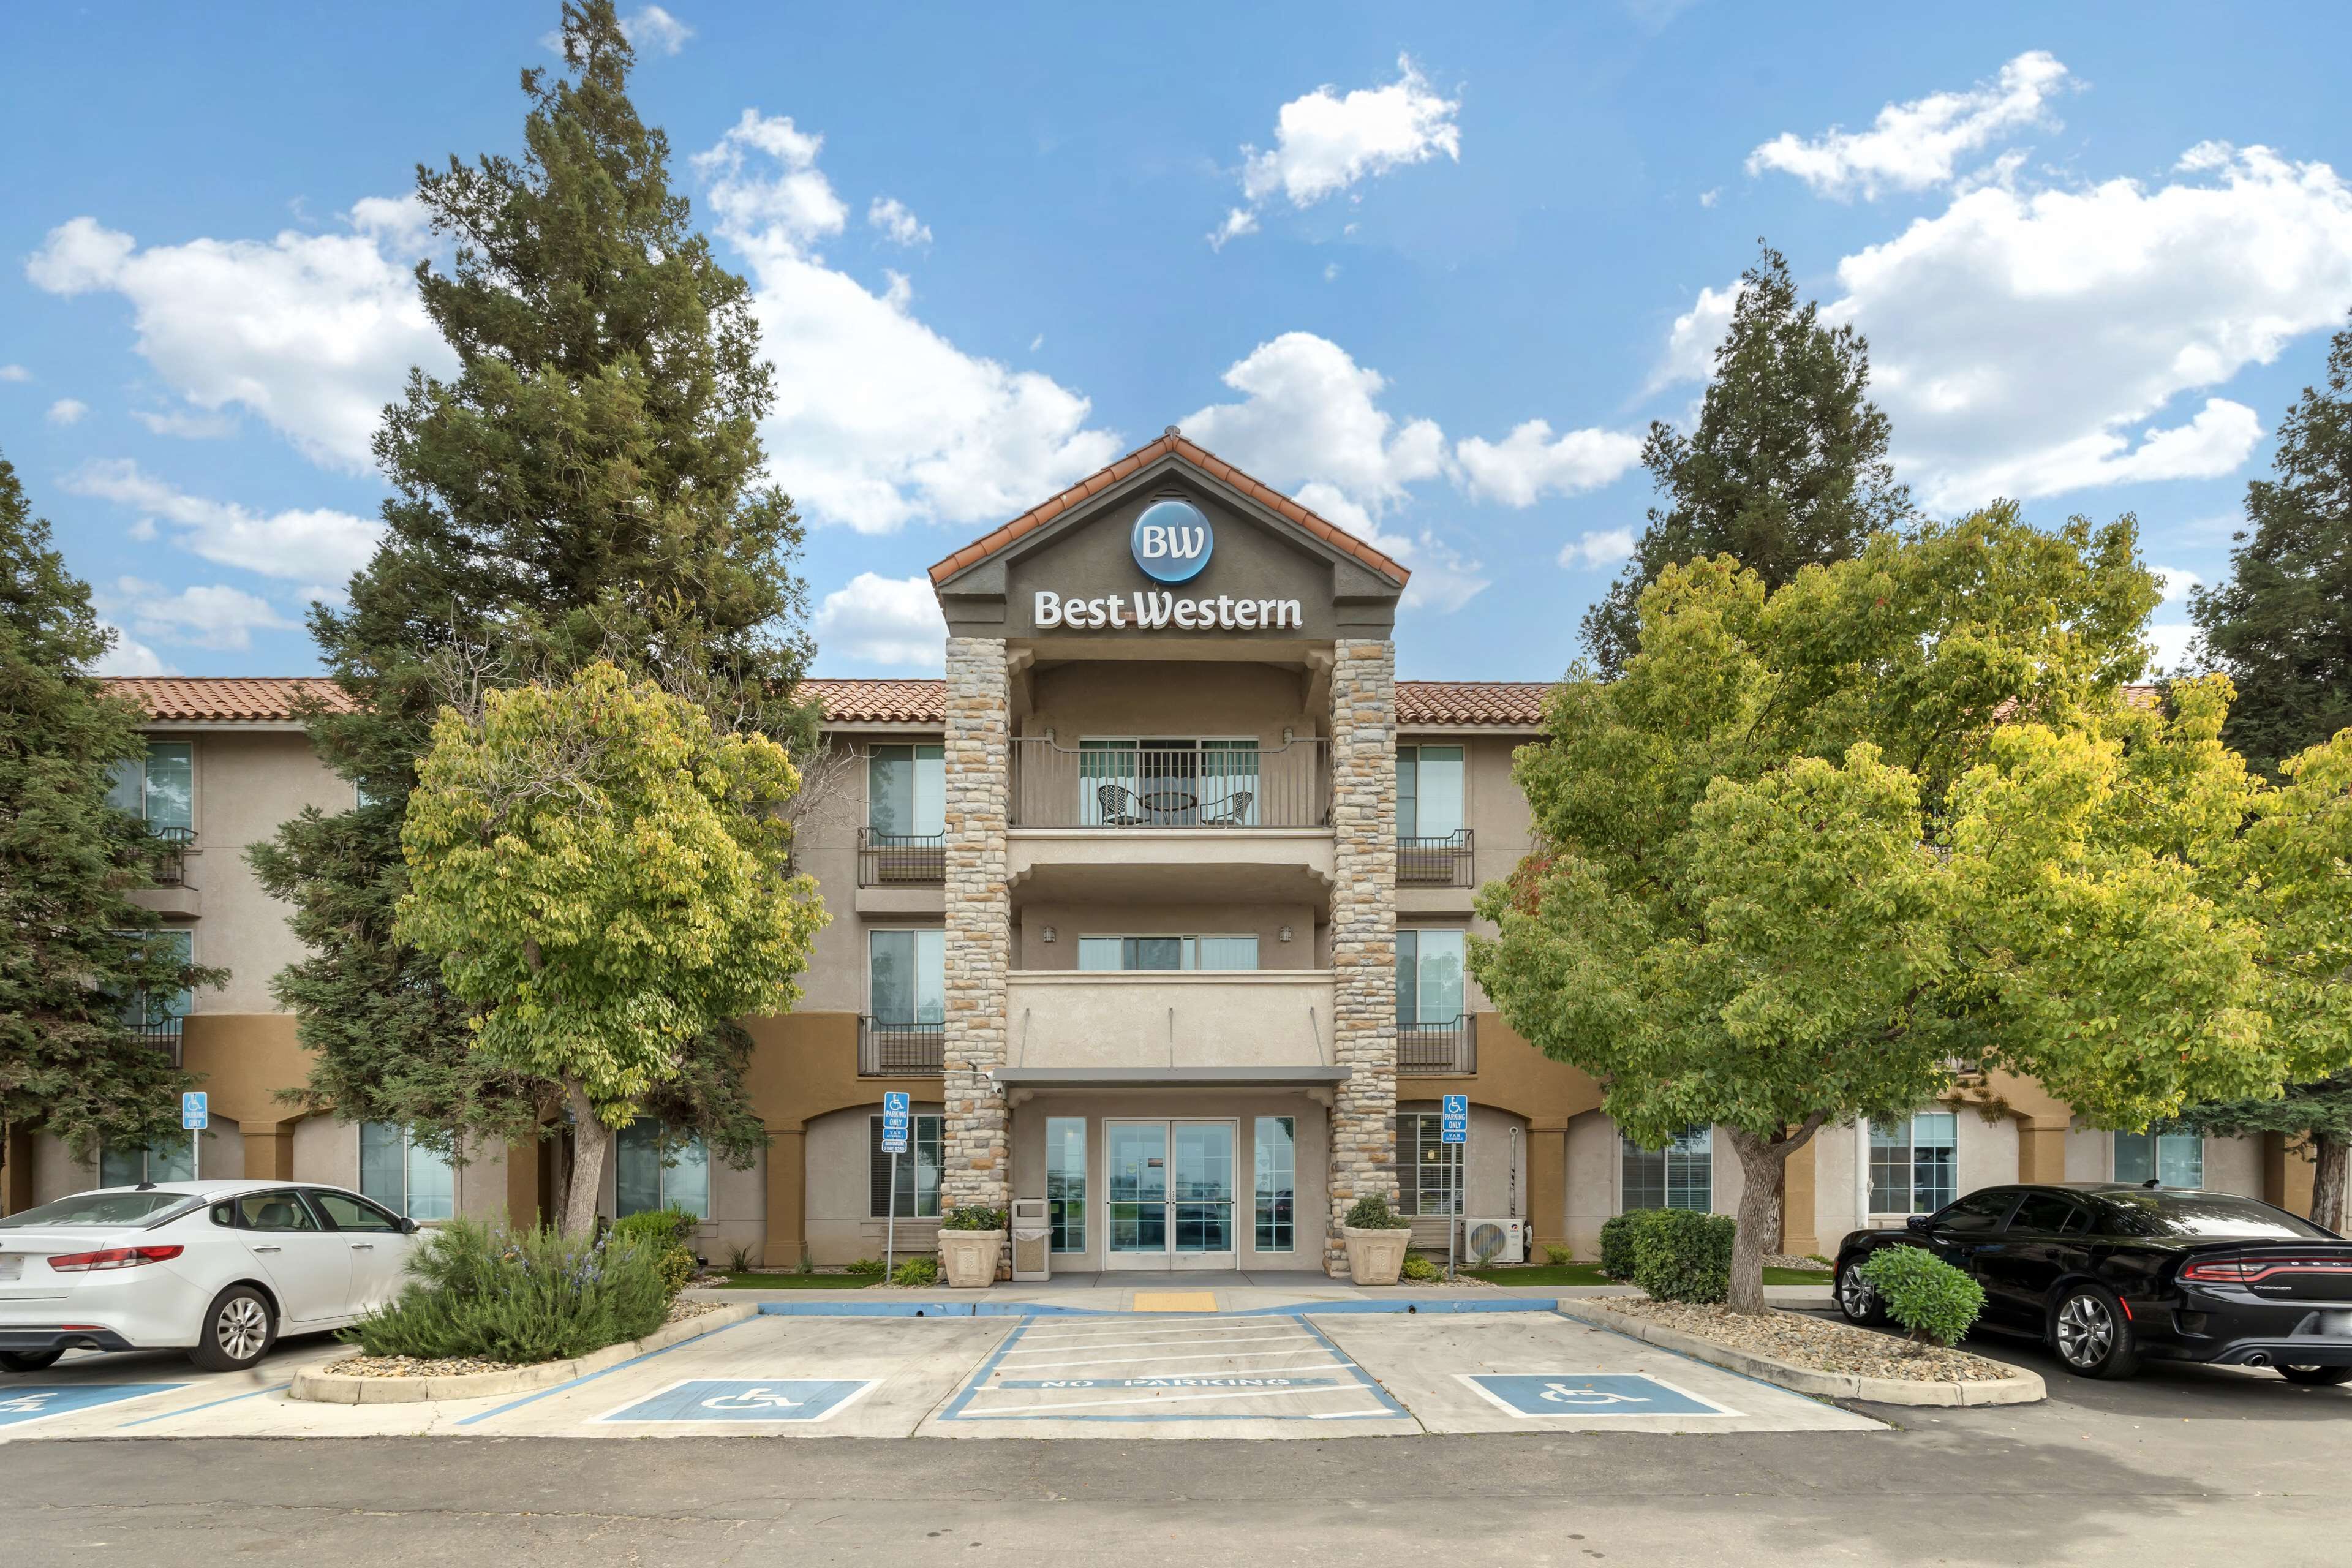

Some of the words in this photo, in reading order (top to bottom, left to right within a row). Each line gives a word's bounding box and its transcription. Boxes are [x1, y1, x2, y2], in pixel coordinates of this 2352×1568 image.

[1142, 526, 1205, 559] BW
[1035, 590, 1127, 629] Best
[1133, 590, 1304, 630] Western
[1124, 1378, 1291, 1387] PARKING
